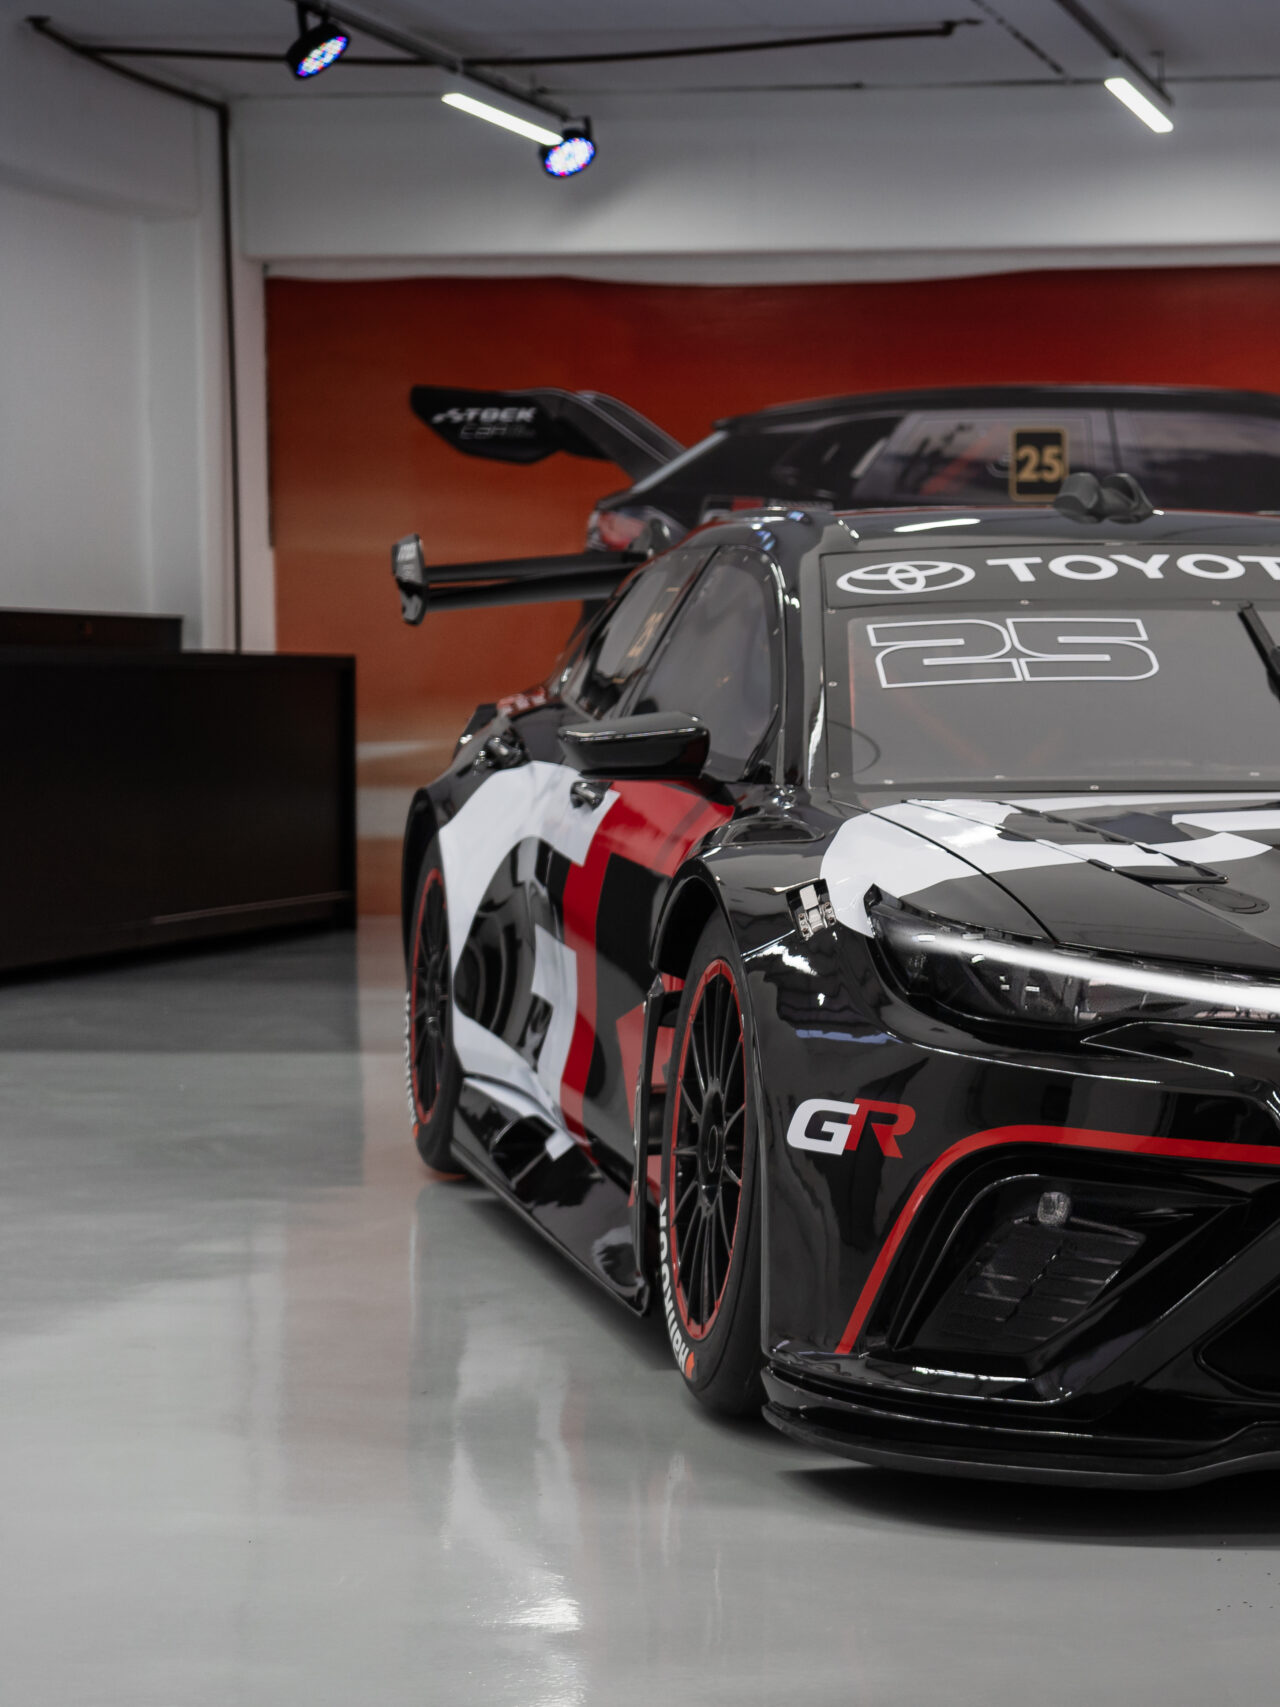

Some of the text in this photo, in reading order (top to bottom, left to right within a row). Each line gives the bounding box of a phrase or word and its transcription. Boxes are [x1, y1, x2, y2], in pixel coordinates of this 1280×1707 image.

[1017, 445, 1063, 483] 25
[866, 618, 1160, 689] 25
[786, 1097, 916, 1159] GR
